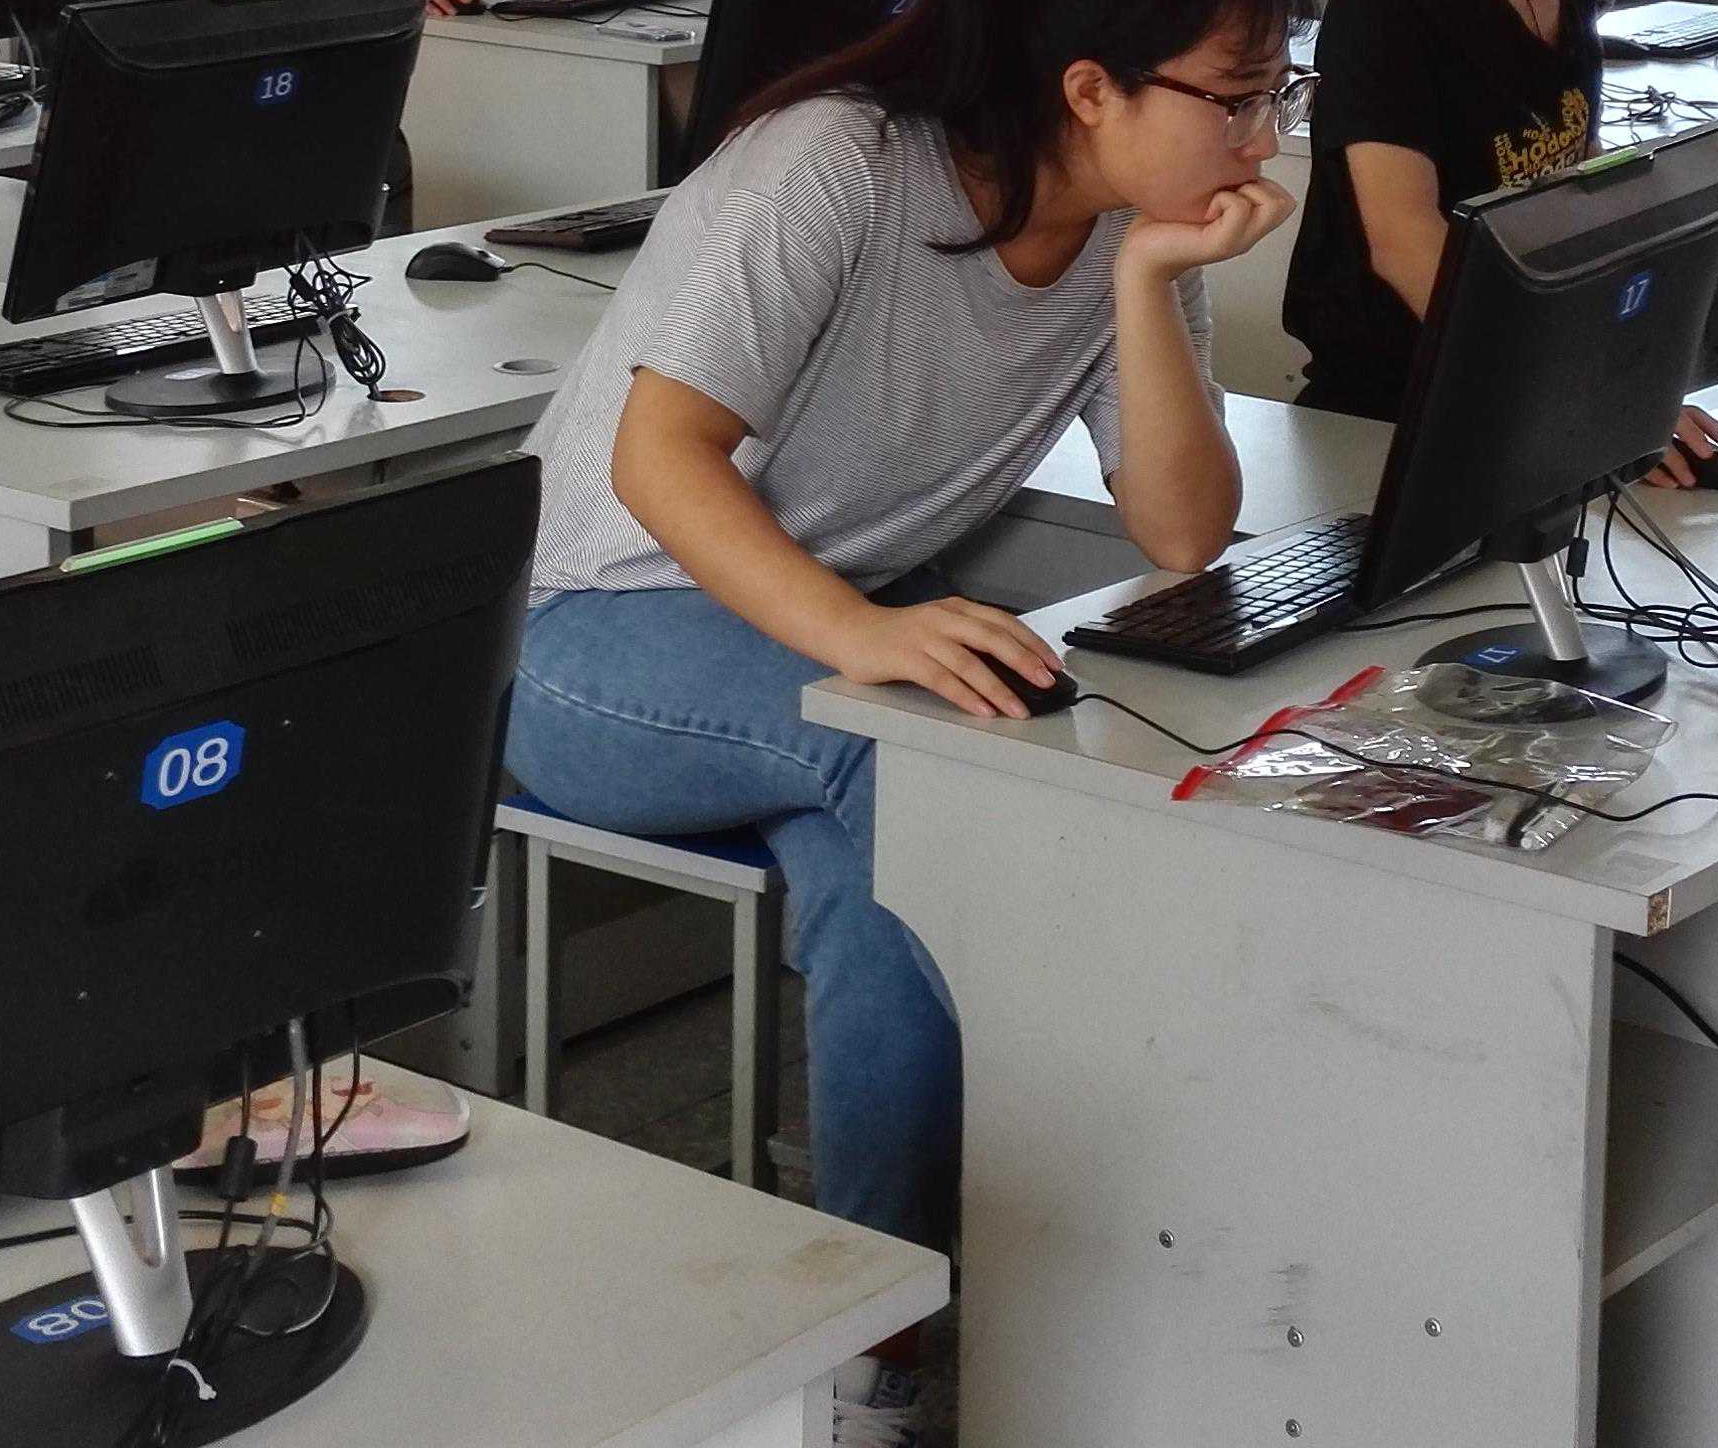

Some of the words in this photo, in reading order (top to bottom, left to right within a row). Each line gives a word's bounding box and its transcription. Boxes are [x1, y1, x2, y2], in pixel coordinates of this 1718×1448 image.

[260, 71, 293, 101] 18
[1620, 278, 1650, 319] 17
[1476, 647, 1517, 663] 17
[158, 735, 229, 798] 08
[27, 1300, 110, 1338] 08
